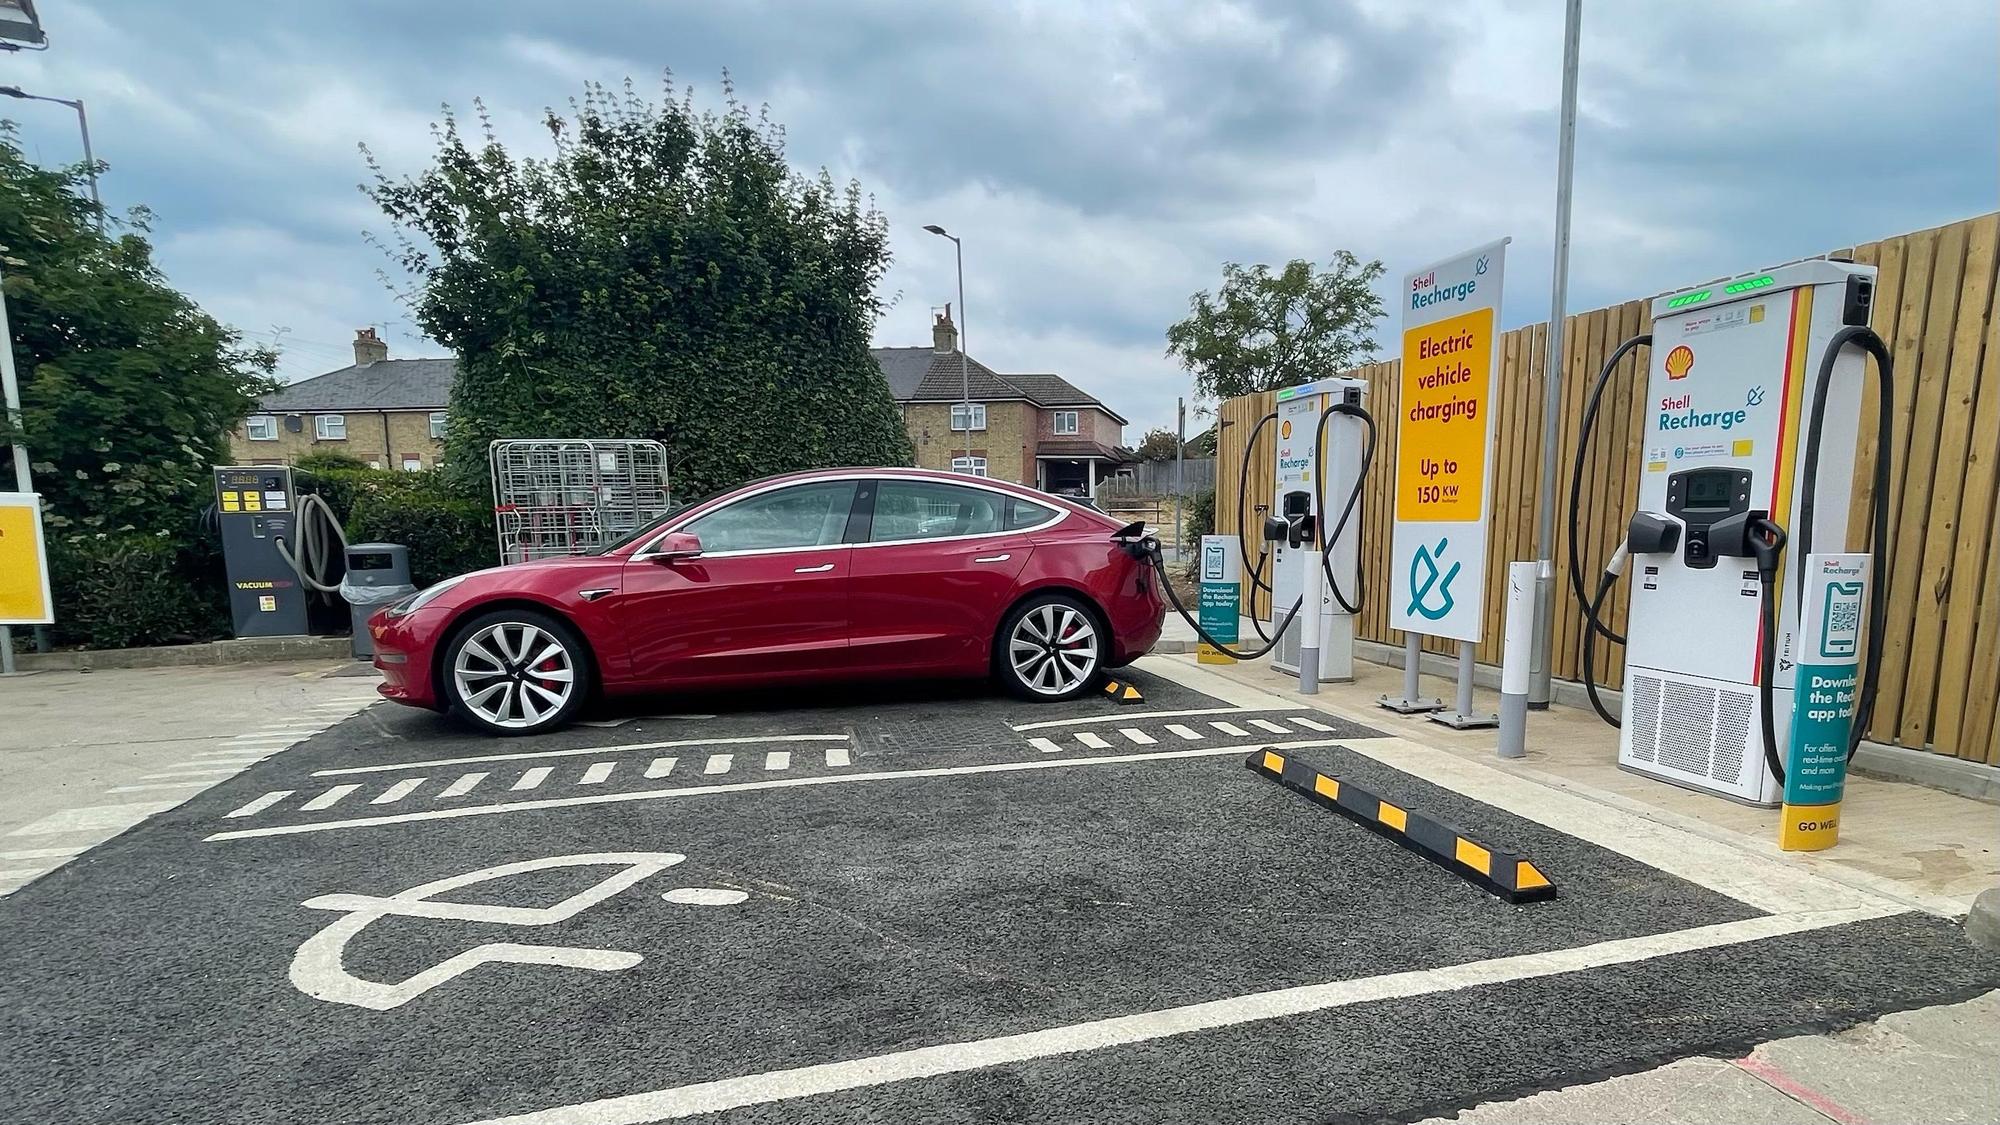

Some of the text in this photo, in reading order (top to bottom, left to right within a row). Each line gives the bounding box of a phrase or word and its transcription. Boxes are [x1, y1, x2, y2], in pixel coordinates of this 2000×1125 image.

[1412, 271, 1435, 292] Shell
[1411, 284, 1476, 310] Recharge
[1419, 328, 1474, 360] Electric
[1418, 361, 1471, 390] vehicle
[1410, 394, 1477, 423] charging
[1661, 394, 1690, 411] Shell
[1659, 408, 1746, 430] Recharge
[1280, 458, 1309, 470] Recharge
[1421, 458, 1458, 480] Up to
[1417, 485, 1459, 504] 150 KW
[1809, 690, 1833, 704] the
[1808, 710, 1836, 723] app
[1803, 743, 1817, 753] For
[1801, 766, 1818, 775] and
[1798, 822, 1817, 831] GO
